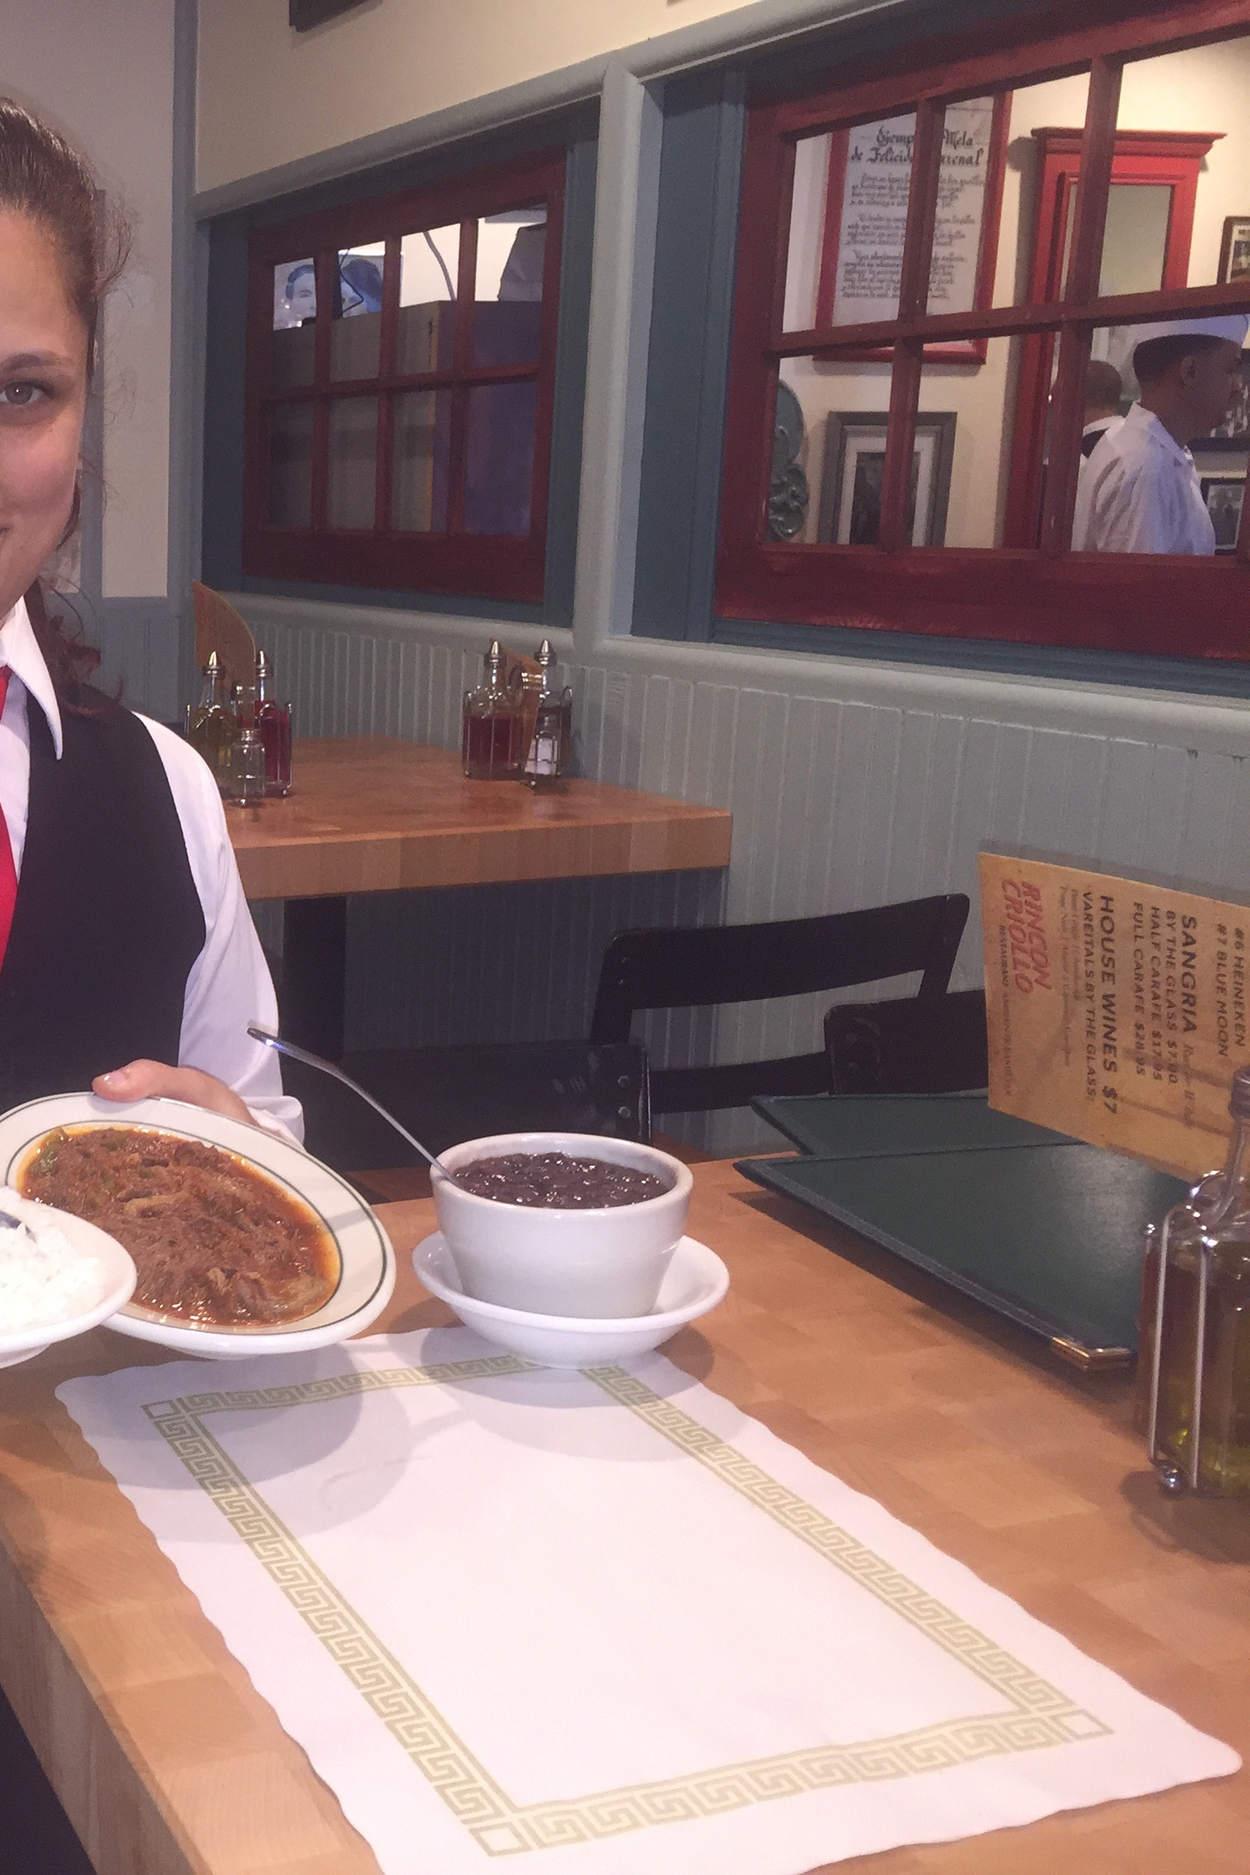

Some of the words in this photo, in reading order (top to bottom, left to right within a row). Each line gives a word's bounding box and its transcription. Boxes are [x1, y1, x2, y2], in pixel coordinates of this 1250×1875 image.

[1001, 879, 1034, 994] CRIOLLO
[1021, 881, 1053, 990] RINCON
[1100, 895, 1116, 986] HOUSE
[1133, 902, 1145, 942] FULL
[1150, 905, 1162, 952] HALF
[1166, 910, 1177, 932] BY
[1216, 923, 1228, 946] #7
[1233, 927, 1245, 951] #6
[1165, 936, 1177, 970] THE
[1181, 914, 1197, 1033] SANGRIA
[1215, 950, 1228, 996] BLUE
[1085, 982, 1096, 1003] BY
[1133, 948, 1145, 1014] CARAFE
[1150, 955, 1162, 1022] CARAFE
[1165, 975, 1178, 1032] GLASS
[1233, 955, 1247, 1047] HEINEKEN
[1085, 1007, 1097, 1040] THE
[1101, 993, 1118, 1073] WINES
[1216, 1000, 1230, 1057] MOON
[1101, 1085, 1118, 1114] $7
